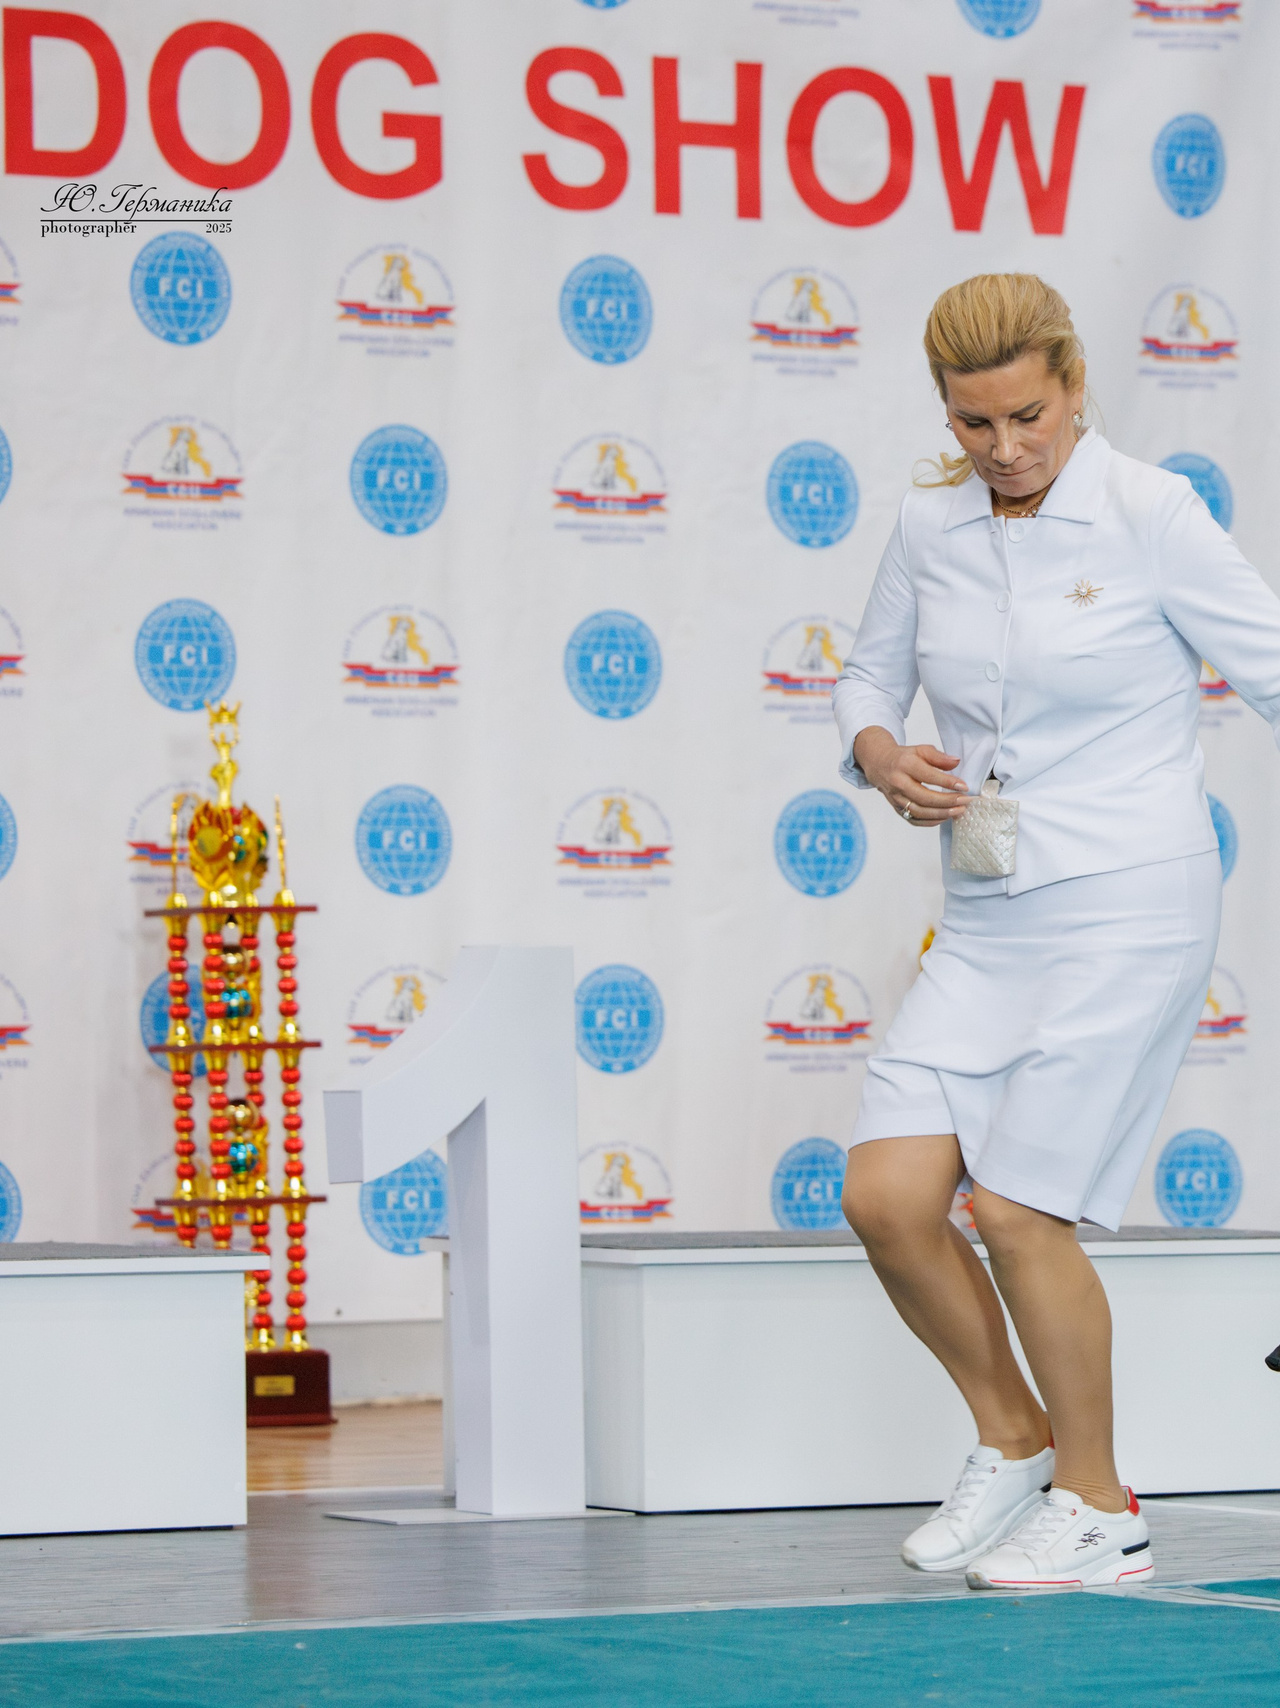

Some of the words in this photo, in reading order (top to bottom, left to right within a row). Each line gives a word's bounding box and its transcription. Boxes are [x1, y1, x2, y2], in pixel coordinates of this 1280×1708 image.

[2, 5, 444, 201] DOG
[522, 45, 1087, 236] SHOW
[159, 278, 203, 299] FCI
[586, 302, 629, 321] FCI
[376, 471, 422, 491] FCI
[792, 486, 835, 505] FCI
[163, 646, 209, 667] FCI
[591, 656, 636, 676] FCI
[381, 832, 428, 852] FCI
[799, 834, 842, 854] FCI
[595, 1010, 639, 1029] FCI
[793, 1182, 835, 1202] FCI
[1175, 1172, 1219, 1192] FCI
[386, 1192, 431, 1210] FCI
[323, 946, 586, 1514] 1
